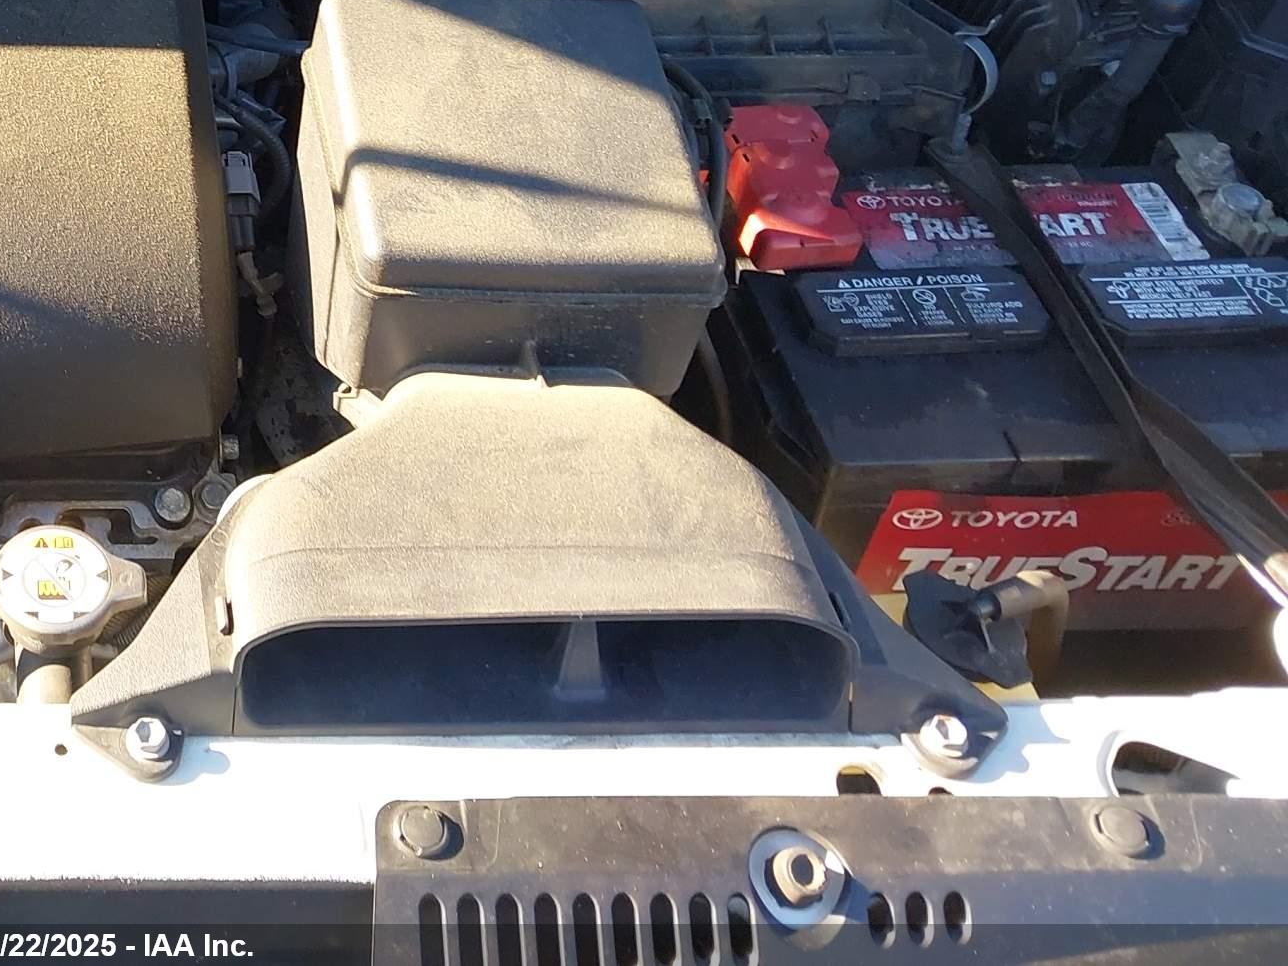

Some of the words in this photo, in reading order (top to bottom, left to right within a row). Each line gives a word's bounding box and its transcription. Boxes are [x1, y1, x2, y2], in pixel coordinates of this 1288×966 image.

[852, 277, 914, 289] DANGER
[927, 273, 984, 285] POISON
[951, 511, 1080, 529] TOYOTA
